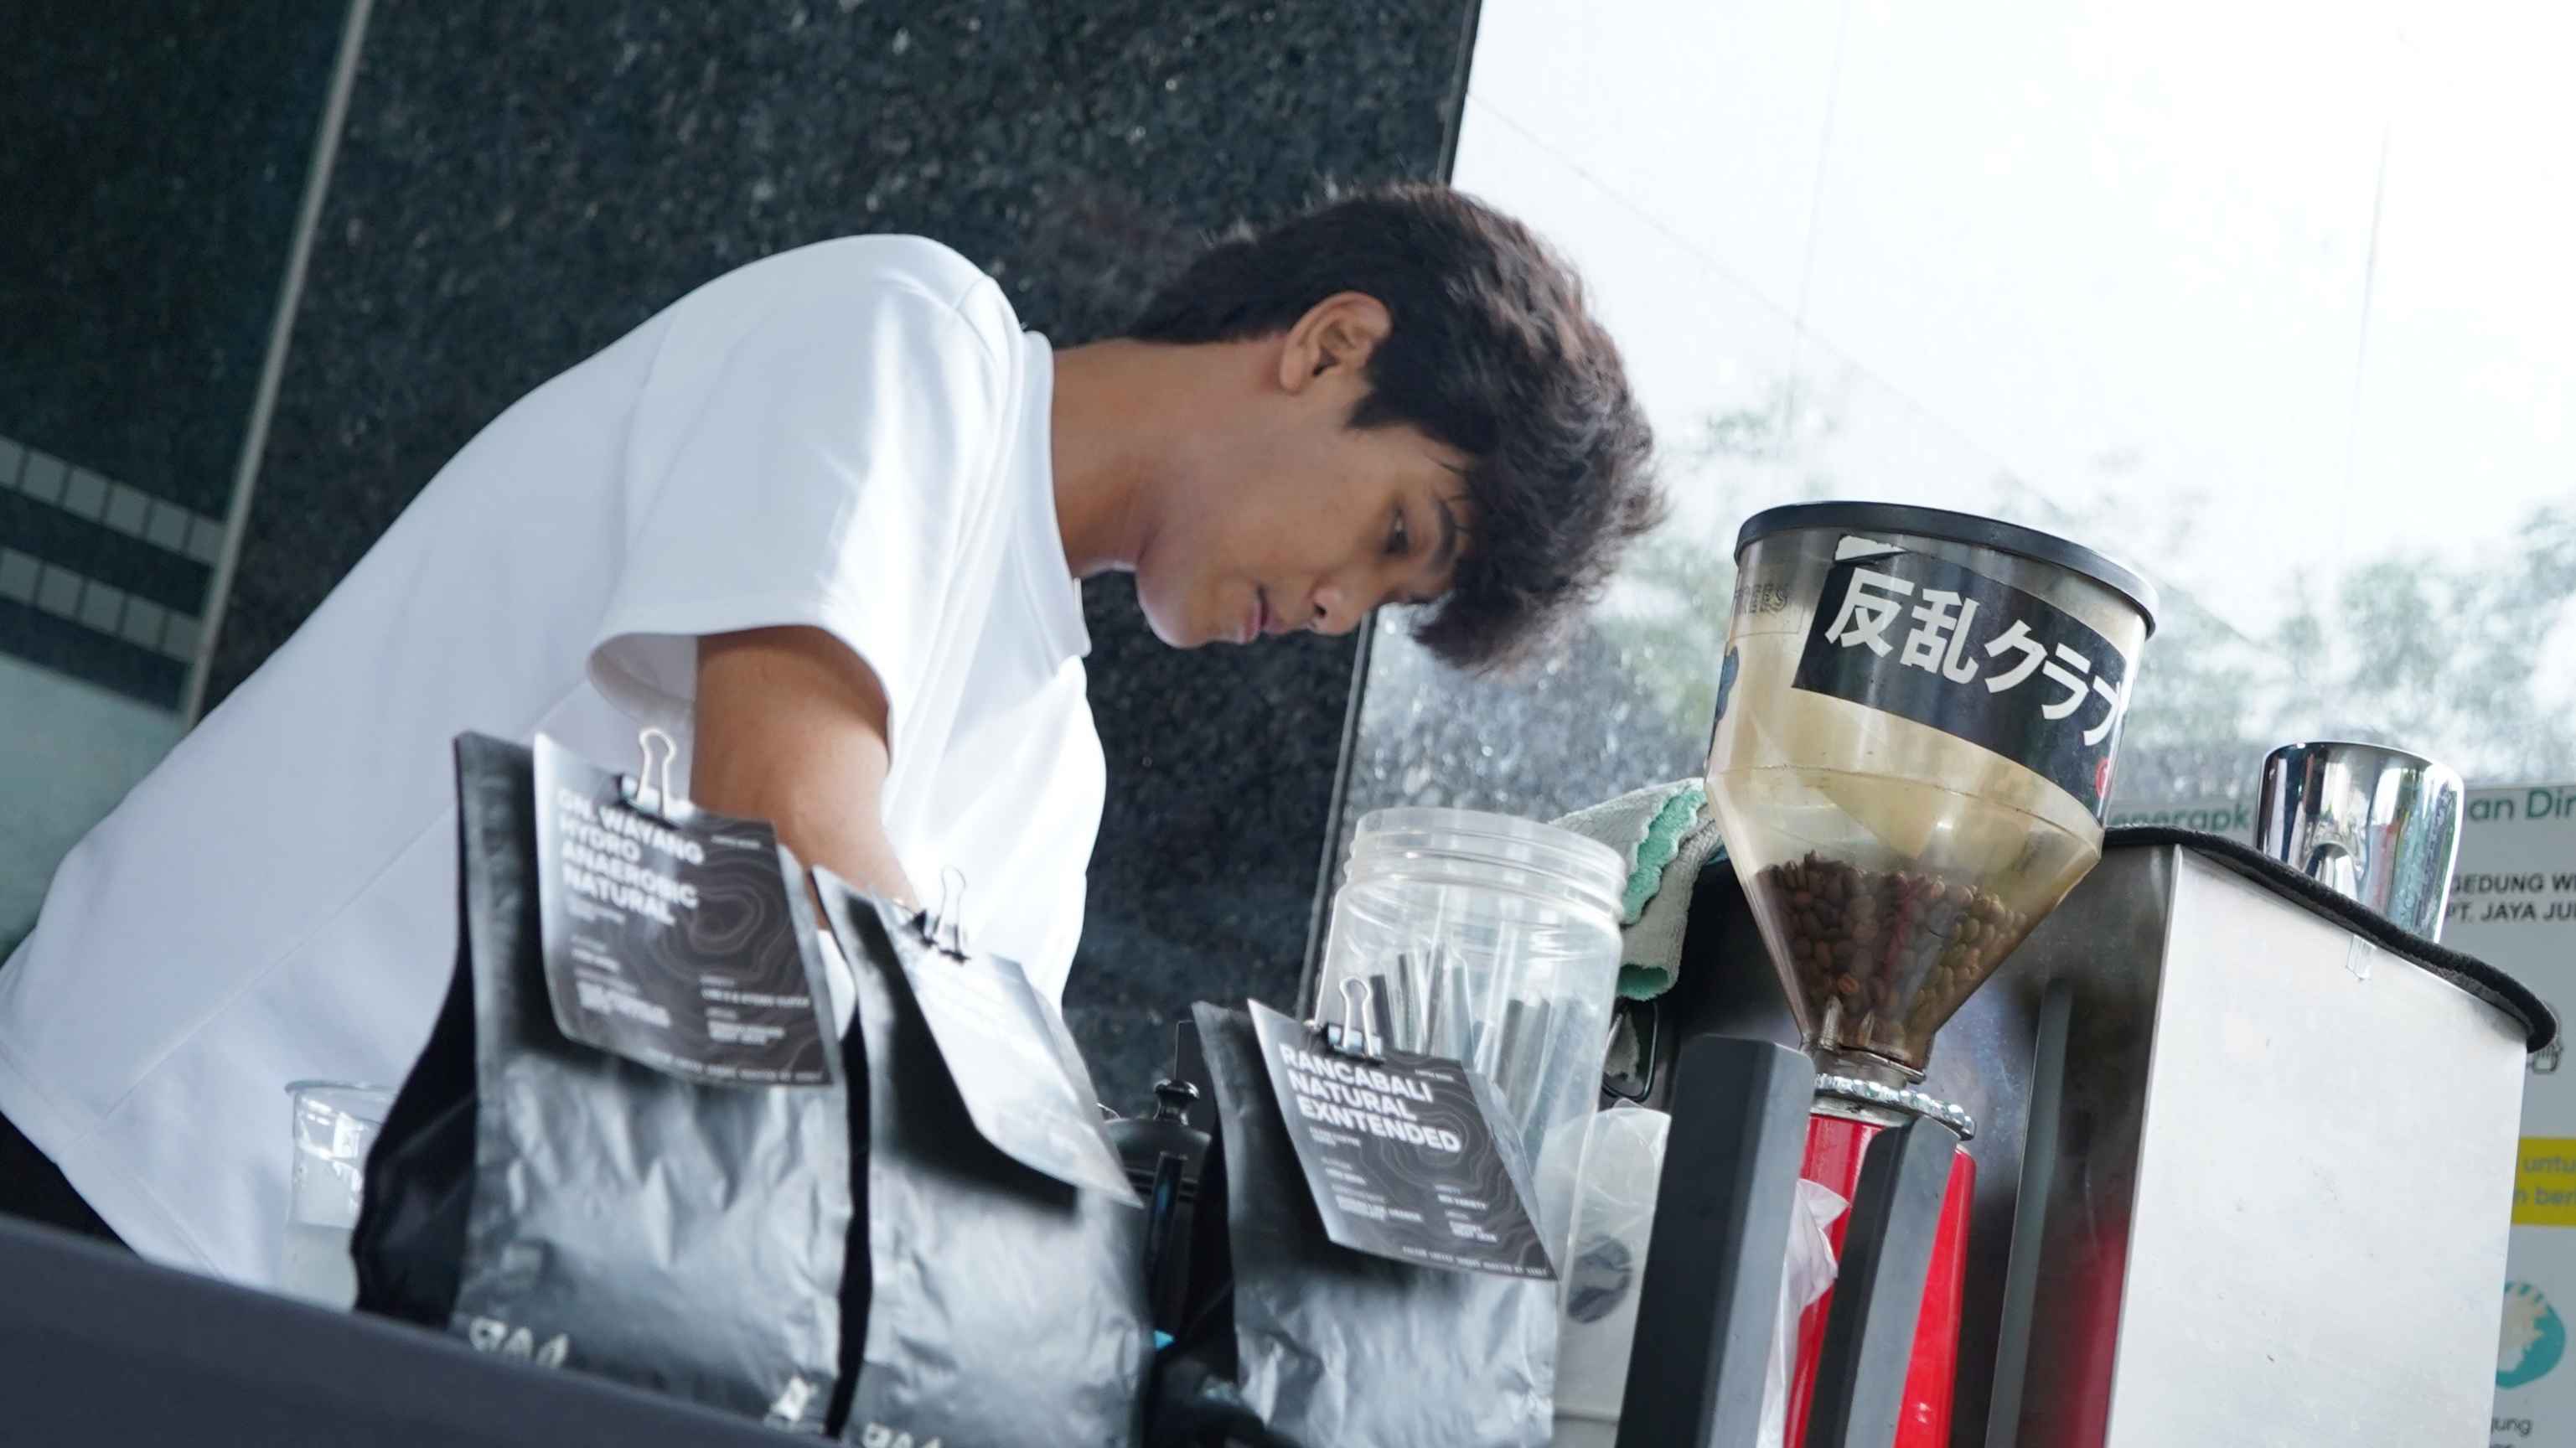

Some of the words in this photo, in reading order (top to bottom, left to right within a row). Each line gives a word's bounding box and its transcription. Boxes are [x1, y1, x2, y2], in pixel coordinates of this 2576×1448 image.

[562, 861, 675, 925] NATURAL
[2480, 901, 2536, 922] JAYA
[1279, 1042, 1434, 1104] RANCABALI
[1287, 1068, 1418, 1121] NATURAL
[1296, 1093, 1461, 1153] EXNTENDED
